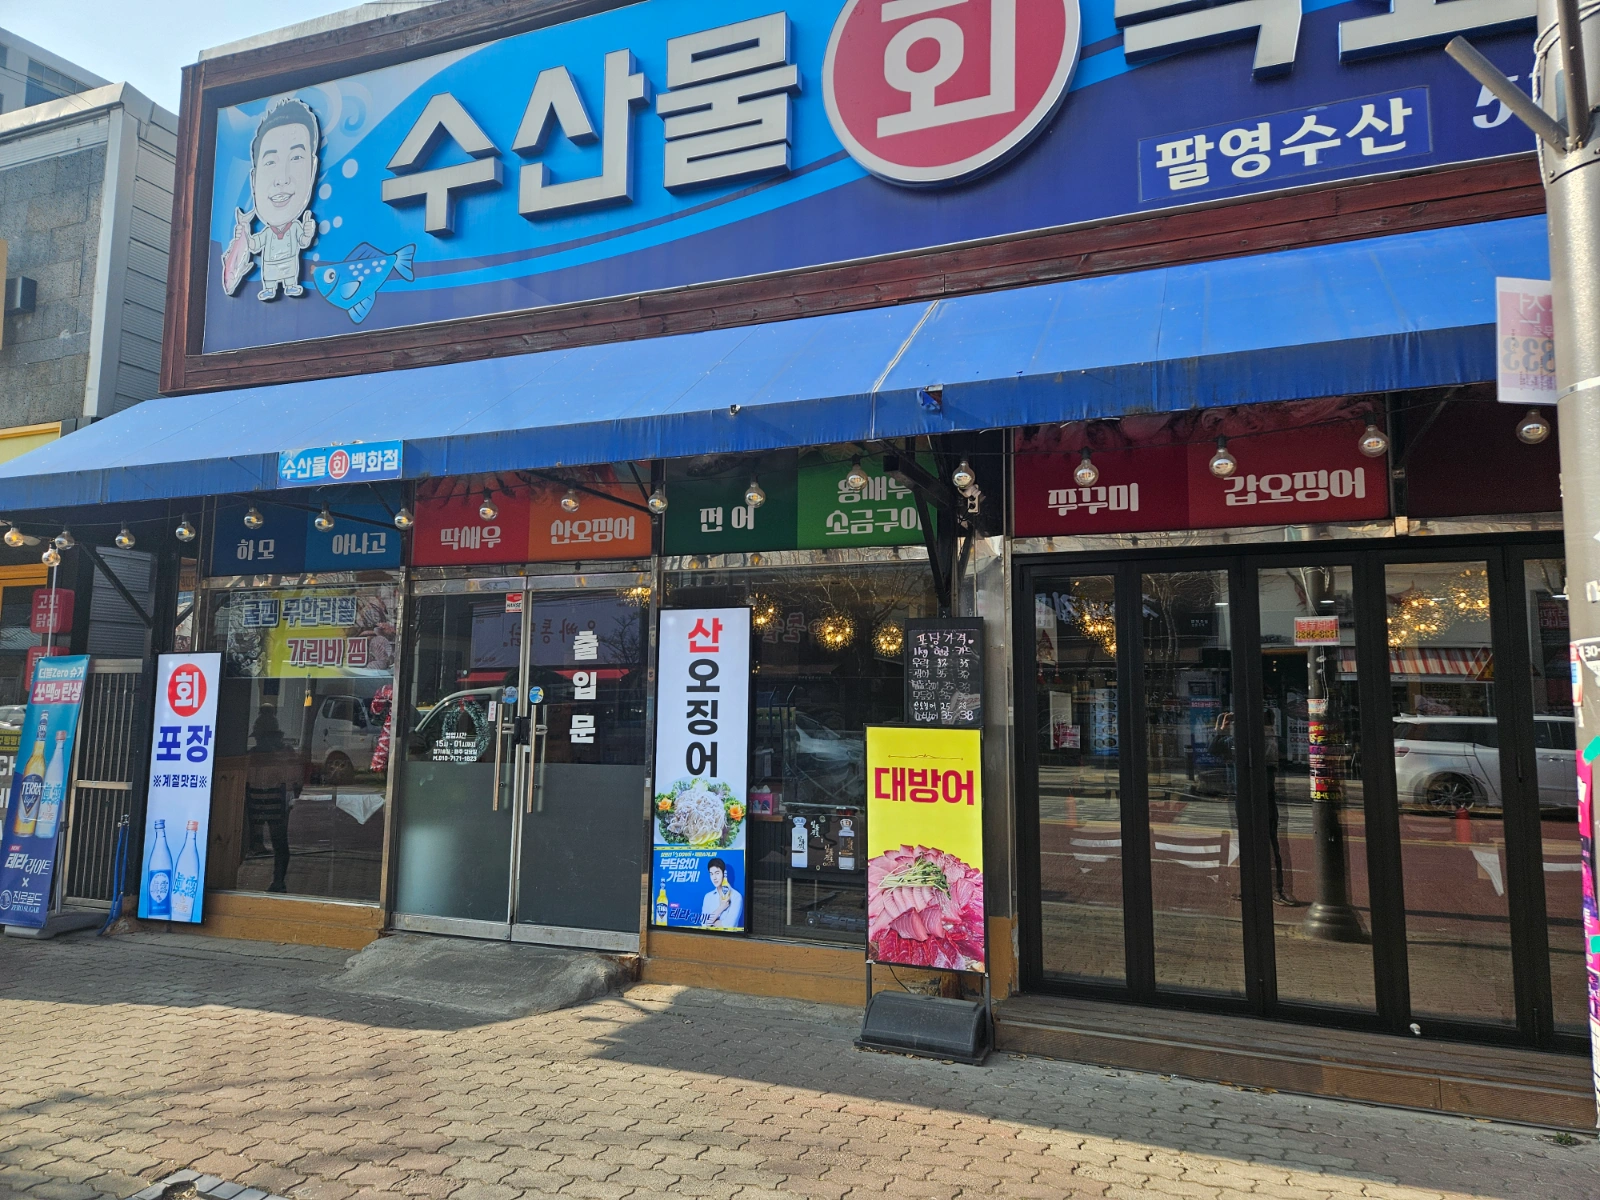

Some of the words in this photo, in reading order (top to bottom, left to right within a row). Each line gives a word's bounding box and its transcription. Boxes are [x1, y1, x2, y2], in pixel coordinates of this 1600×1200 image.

[382, 12, 801, 236] 수산물
[877, 0, 1015, 138] 회
[1156, 98, 1412, 190] 팔영수산
[282, 456, 326, 479] 수산물
[333, 455, 346, 475] 회
[351, 449, 399, 473] 백화점
[1048, 483, 1139, 516] 쭈꾸미
[1224, 467, 1366, 506] 갑오징어
[237, 539, 275, 560] 하모
[440, 526, 502, 550] 딱새우
[551, 516, 635, 544] 산오징어
[287, 637, 345, 668] 가리비
[347, 637, 368, 667] 찜
[33, 682, 61, 702] 쏘맥의
[61, 681, 82, 701] 탄생
[174, 671, 200, 708] 회
[569, 630, 599, 743] 출입문
[685, 617, 724, 778] 산오징어
[156, 725, 213, 763] 포장
[22, 782, 42, 796] TERRA
[873, 766, 976, 806] 대방어
[660, 857, 700, 870] 부담없이
[666, 870, 701, 883] 가볍게!
[12, 890, 43, 906] 진로골드
